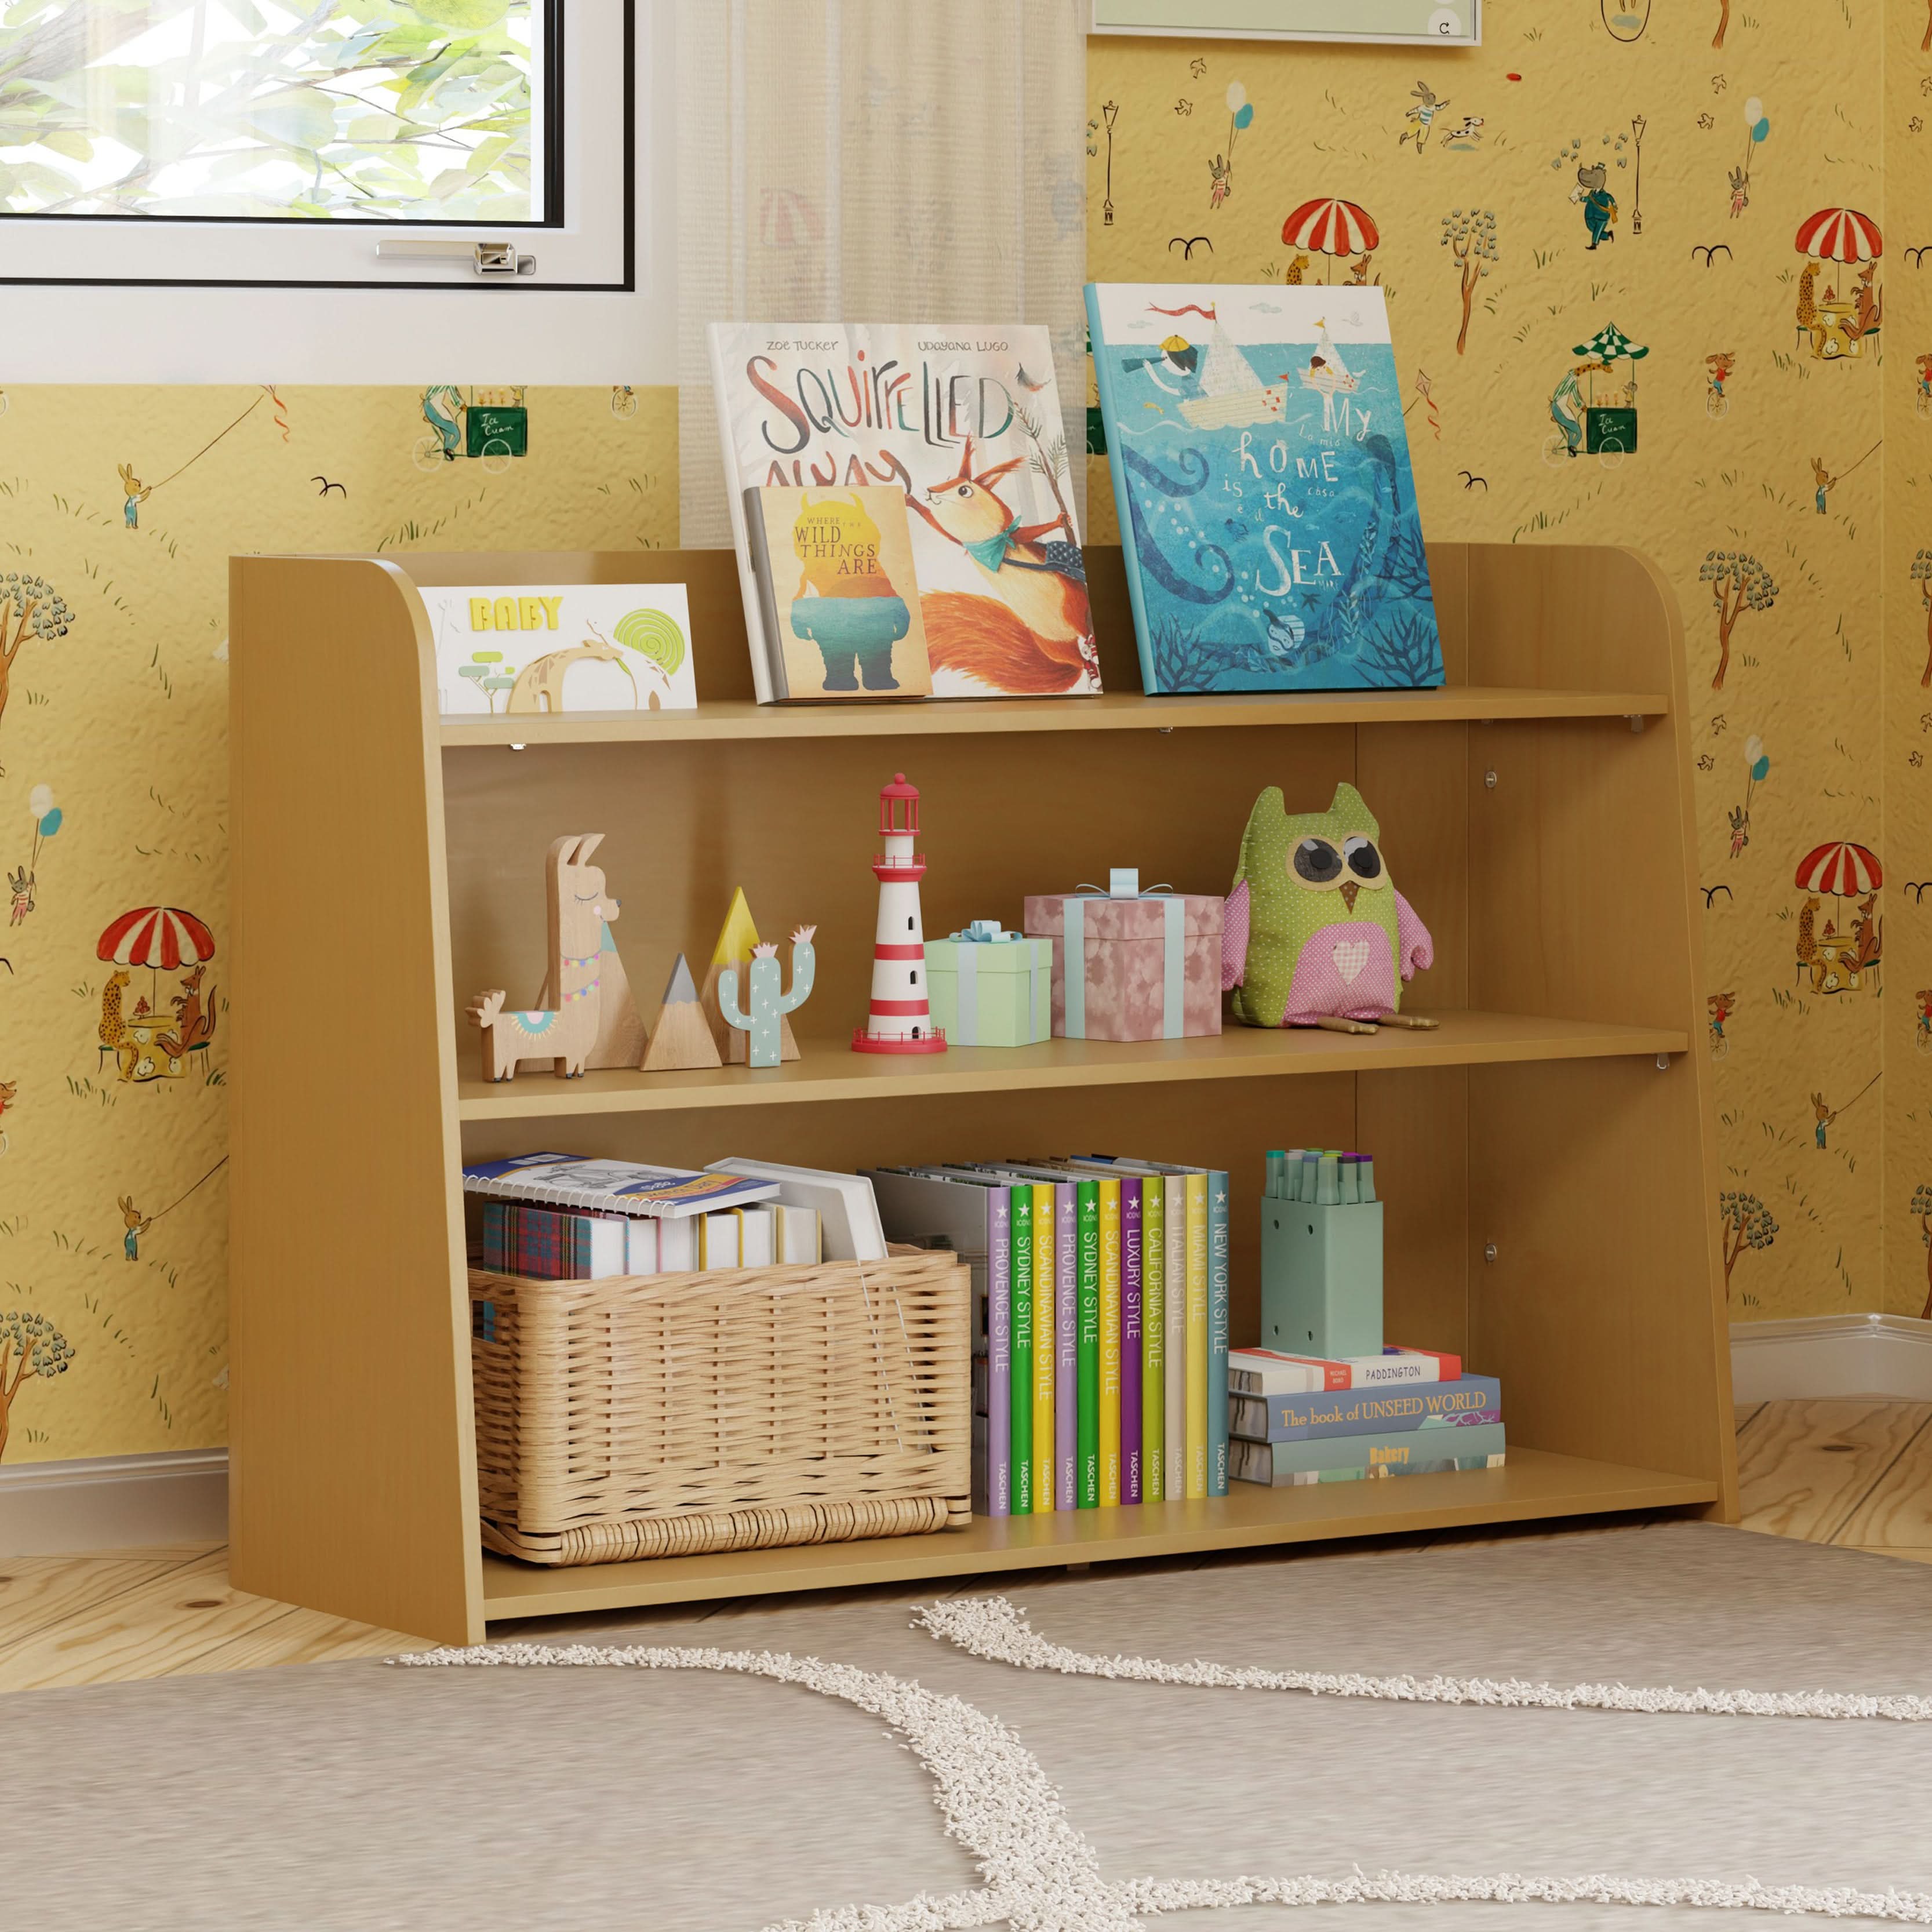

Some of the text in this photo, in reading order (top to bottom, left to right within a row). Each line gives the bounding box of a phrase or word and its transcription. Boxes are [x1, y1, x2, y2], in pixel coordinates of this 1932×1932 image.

[976, 341, 1009, 351] LUGO
[807, 516, 841, 525] WHERE
[1263, 482, 1304, 518] the
[795, 525, 841, 544] WILD
[800, 543, 875, 558] THINGS
[836, 558, 878, 575] ARE
[1254, 525, 1343, 596] SEA
[469, 596, 564, 631] BABY
[1171, 1226, 1184, 1283] ITALIAN
[1192, 1225, 1206, 1271] MIAMI
[995, 1238, 1009, 1320] PROVENCE
[1017, 1236, 1031, 1349] SYDNEY STYLE
[1039, 1235, 1053, 1349] SCANDINAVIAN
[1061, 1234, 1076, 1367] PROVENCE STYLE
[1083, 1232, 1097, 1344] SYDNEY STYLE
[1105, 1230, 1119, 1344] SCANDINAVIAN
[1127, 1229, 1140, 1340] LUXURY STYLE
[1148, 1228, 1162, 1369] CALIFORNIA STYLE
[1192, 1275, 1206, 1322] STYLE
[1214, 1223, 1227, 1355] NEW YORK STYLE
[1171, 1287, 1184, 1334] STYLE
[995, 1325, 1009, 1373] STYLE
[1105, 1348, 1119, 1395] STYLE
[1039, 1354, 1053, 1401] STYLE
[1366, 1366, 1421, 1381] PADDINGTON
[1281, 1391, 1487, 1428] The book of UNSEED WORLD
[998, 1462, 1006, 1509] TASCHEN
[1020, 1460, 1028, 1508] TASCHEN
[1065, 1456, 1074, 1504] TASCHEN
[1087, 1454, 1095, 1502] TASCHEN
[1108, 1452, 1116, 1500] TASCHEN
[1151, 1449, 1159, 1496] TASCHEN
[1173, 1446, 1182, 1494] TASCHEN
[1196, 1445, 1204, 1493] TASCHEN
[1217, 1442, 1225, 1490] TASCHEN
